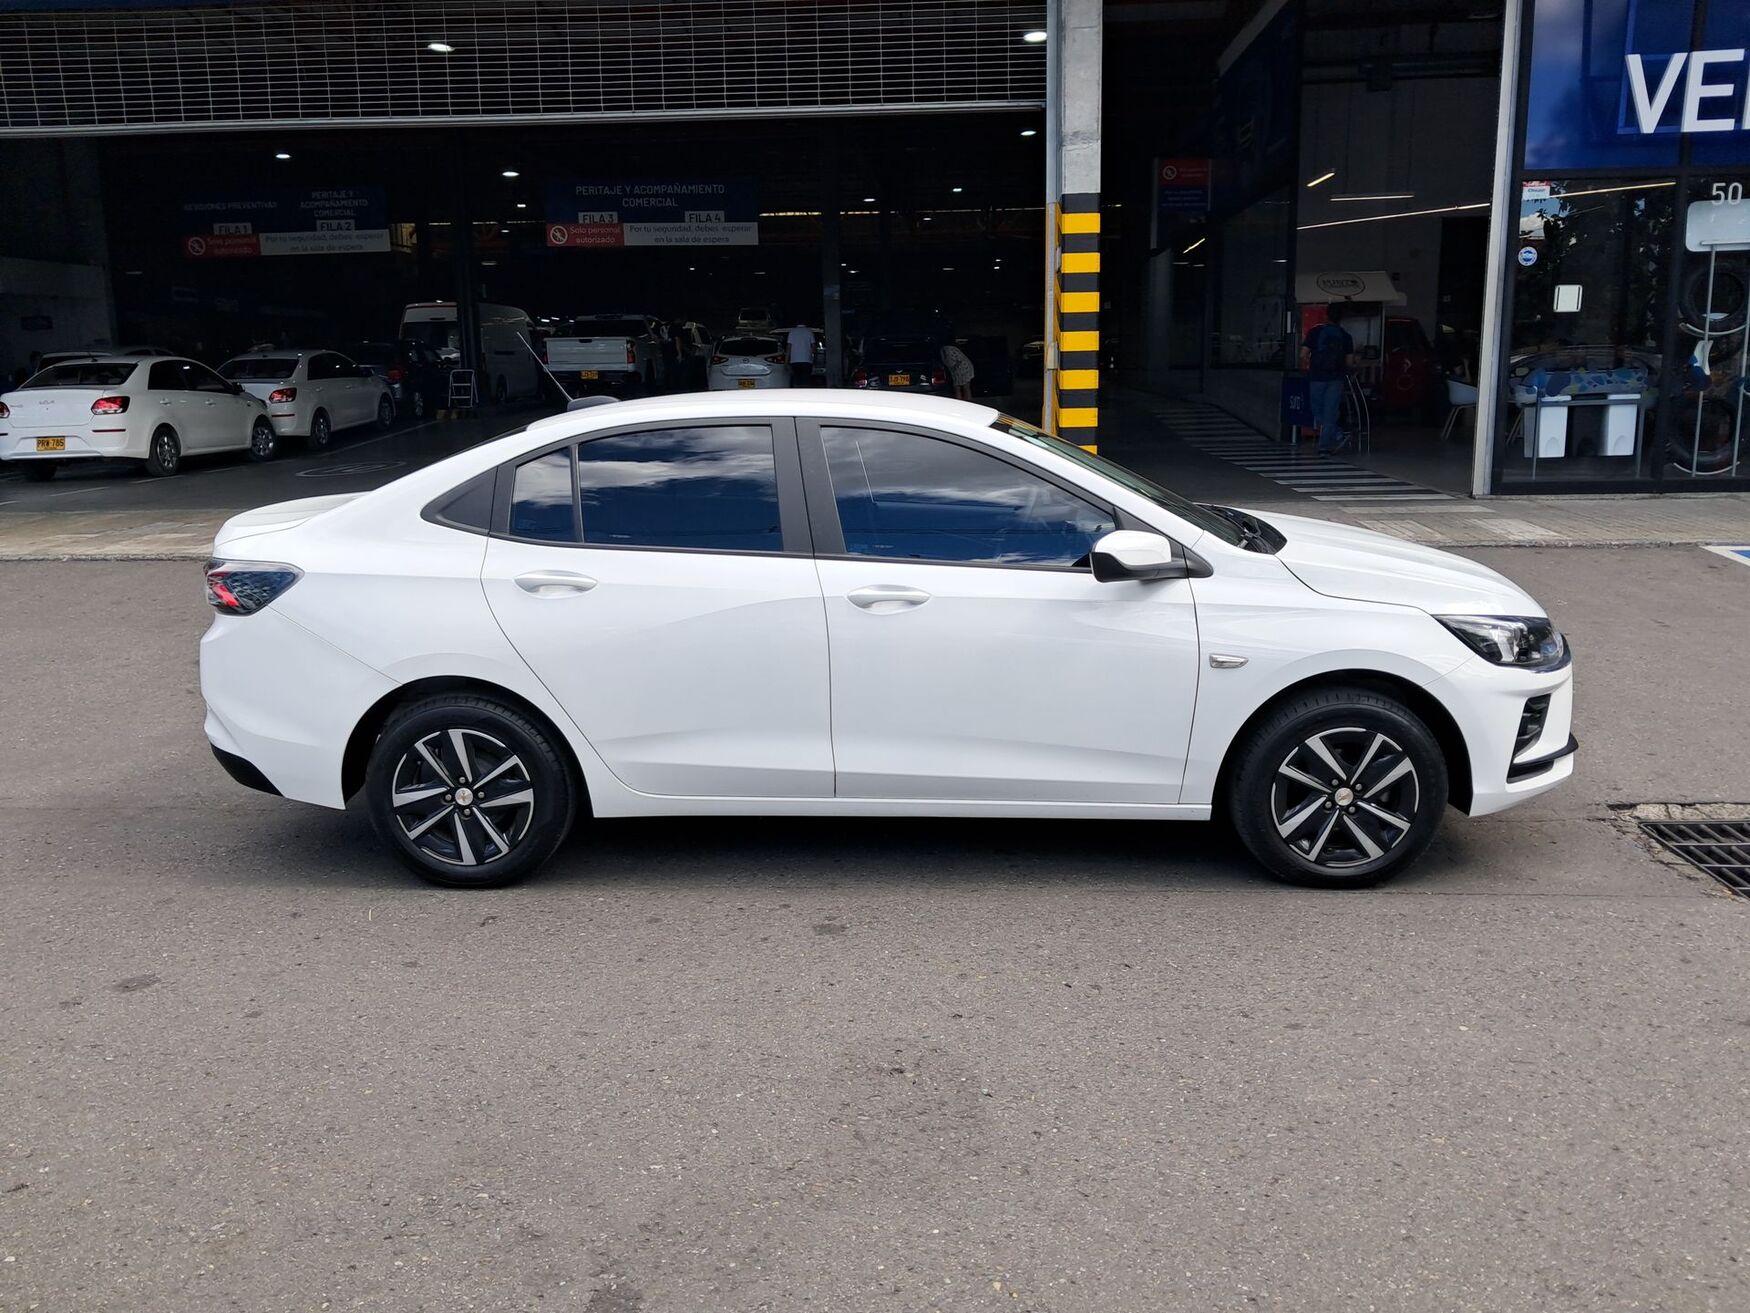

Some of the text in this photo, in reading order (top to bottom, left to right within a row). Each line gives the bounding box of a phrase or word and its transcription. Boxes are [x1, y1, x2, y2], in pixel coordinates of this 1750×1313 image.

[1625, 48, 1750, 134] VE
[575, 182, 725, 196] PERITAJE Y ACOMPAÑAMIENTO
[1712, 181, 1744, 206] 50
[622, 197, 679, 208] COMERCIAL
[582, 214, 614, 224] FILA 3
[688, 213, 722, 223] FILA 4
[218, 225, 241, 235] FILA
[319, 221, 352, 232] FILA 2
[570, 226, 620, 235] Solo personal
[629, 225, 641, 233] Por
